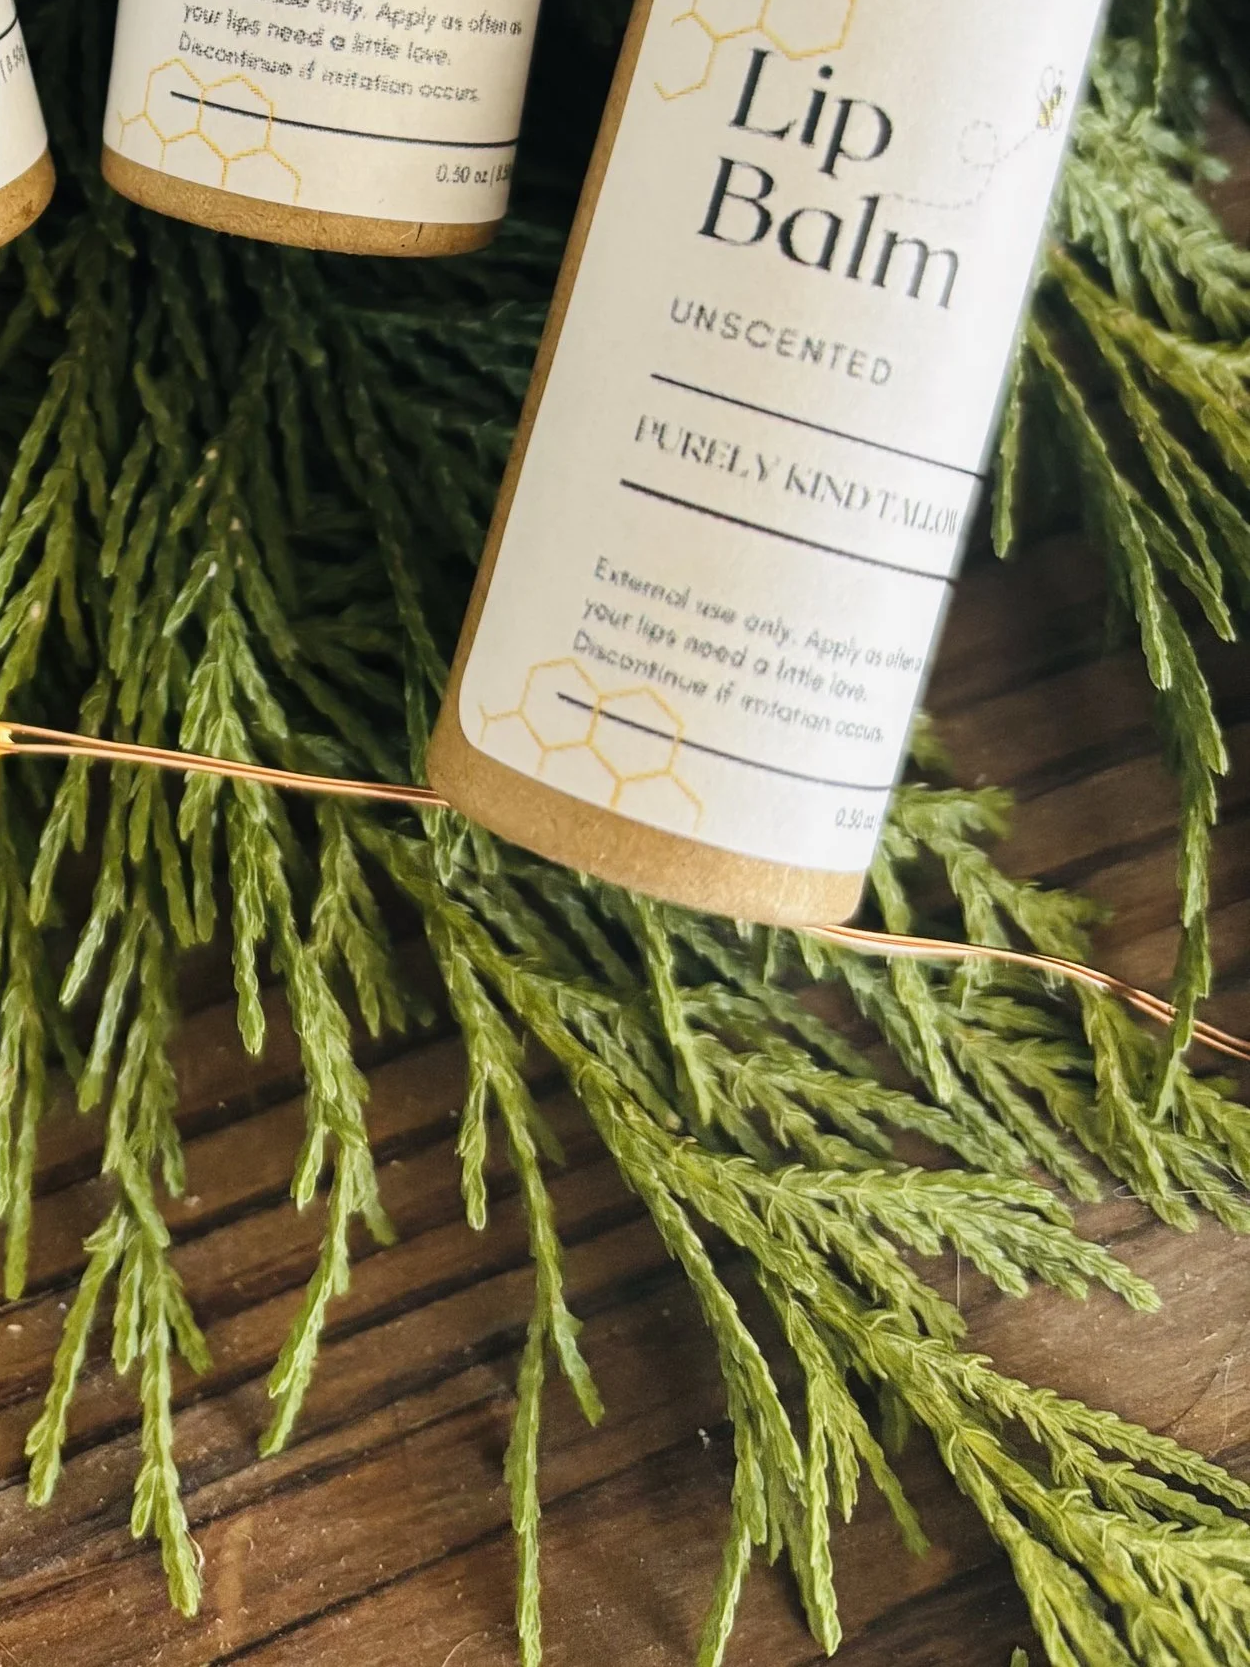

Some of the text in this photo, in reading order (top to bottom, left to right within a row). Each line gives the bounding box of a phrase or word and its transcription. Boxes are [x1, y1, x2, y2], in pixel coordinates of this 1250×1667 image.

[178, 31, 293, 77] Discontinue
[299, 60, 316, 80] if
[322, 69, 413, 95] irritation
[183, 2, 223, 26] your
[226, 8, 260, 37] lips
[267, 22, 324, 47] need
[330, 34, 346, 51] a
[351, 33, 401, 60] little
[375, 1, 437, 34] Apply
[441, 14, 463, 32] as
[468, 9, 508, 35] often
[728, 48, 893, 180] Lip
[697, 156, 960, 310] Balm
[669, 295, 892, 387] UNSCENTED
[634, 413, 780, 482] PURELY
[784, 461, 871, 511] KIND
[581, 598, 868, 702] your lips need a little love.
[592, 555, 691, 609] External
[696, 598, 737, 624] use
[743, 613, 796, 646] only.
[805, 629, 861, 664] Apply
[864, 649, 884, 667] as
[573, 628, 709, 695] Discontinue
[715, 680, 735, 705] if
[739, 690, 832, 733] irritation
